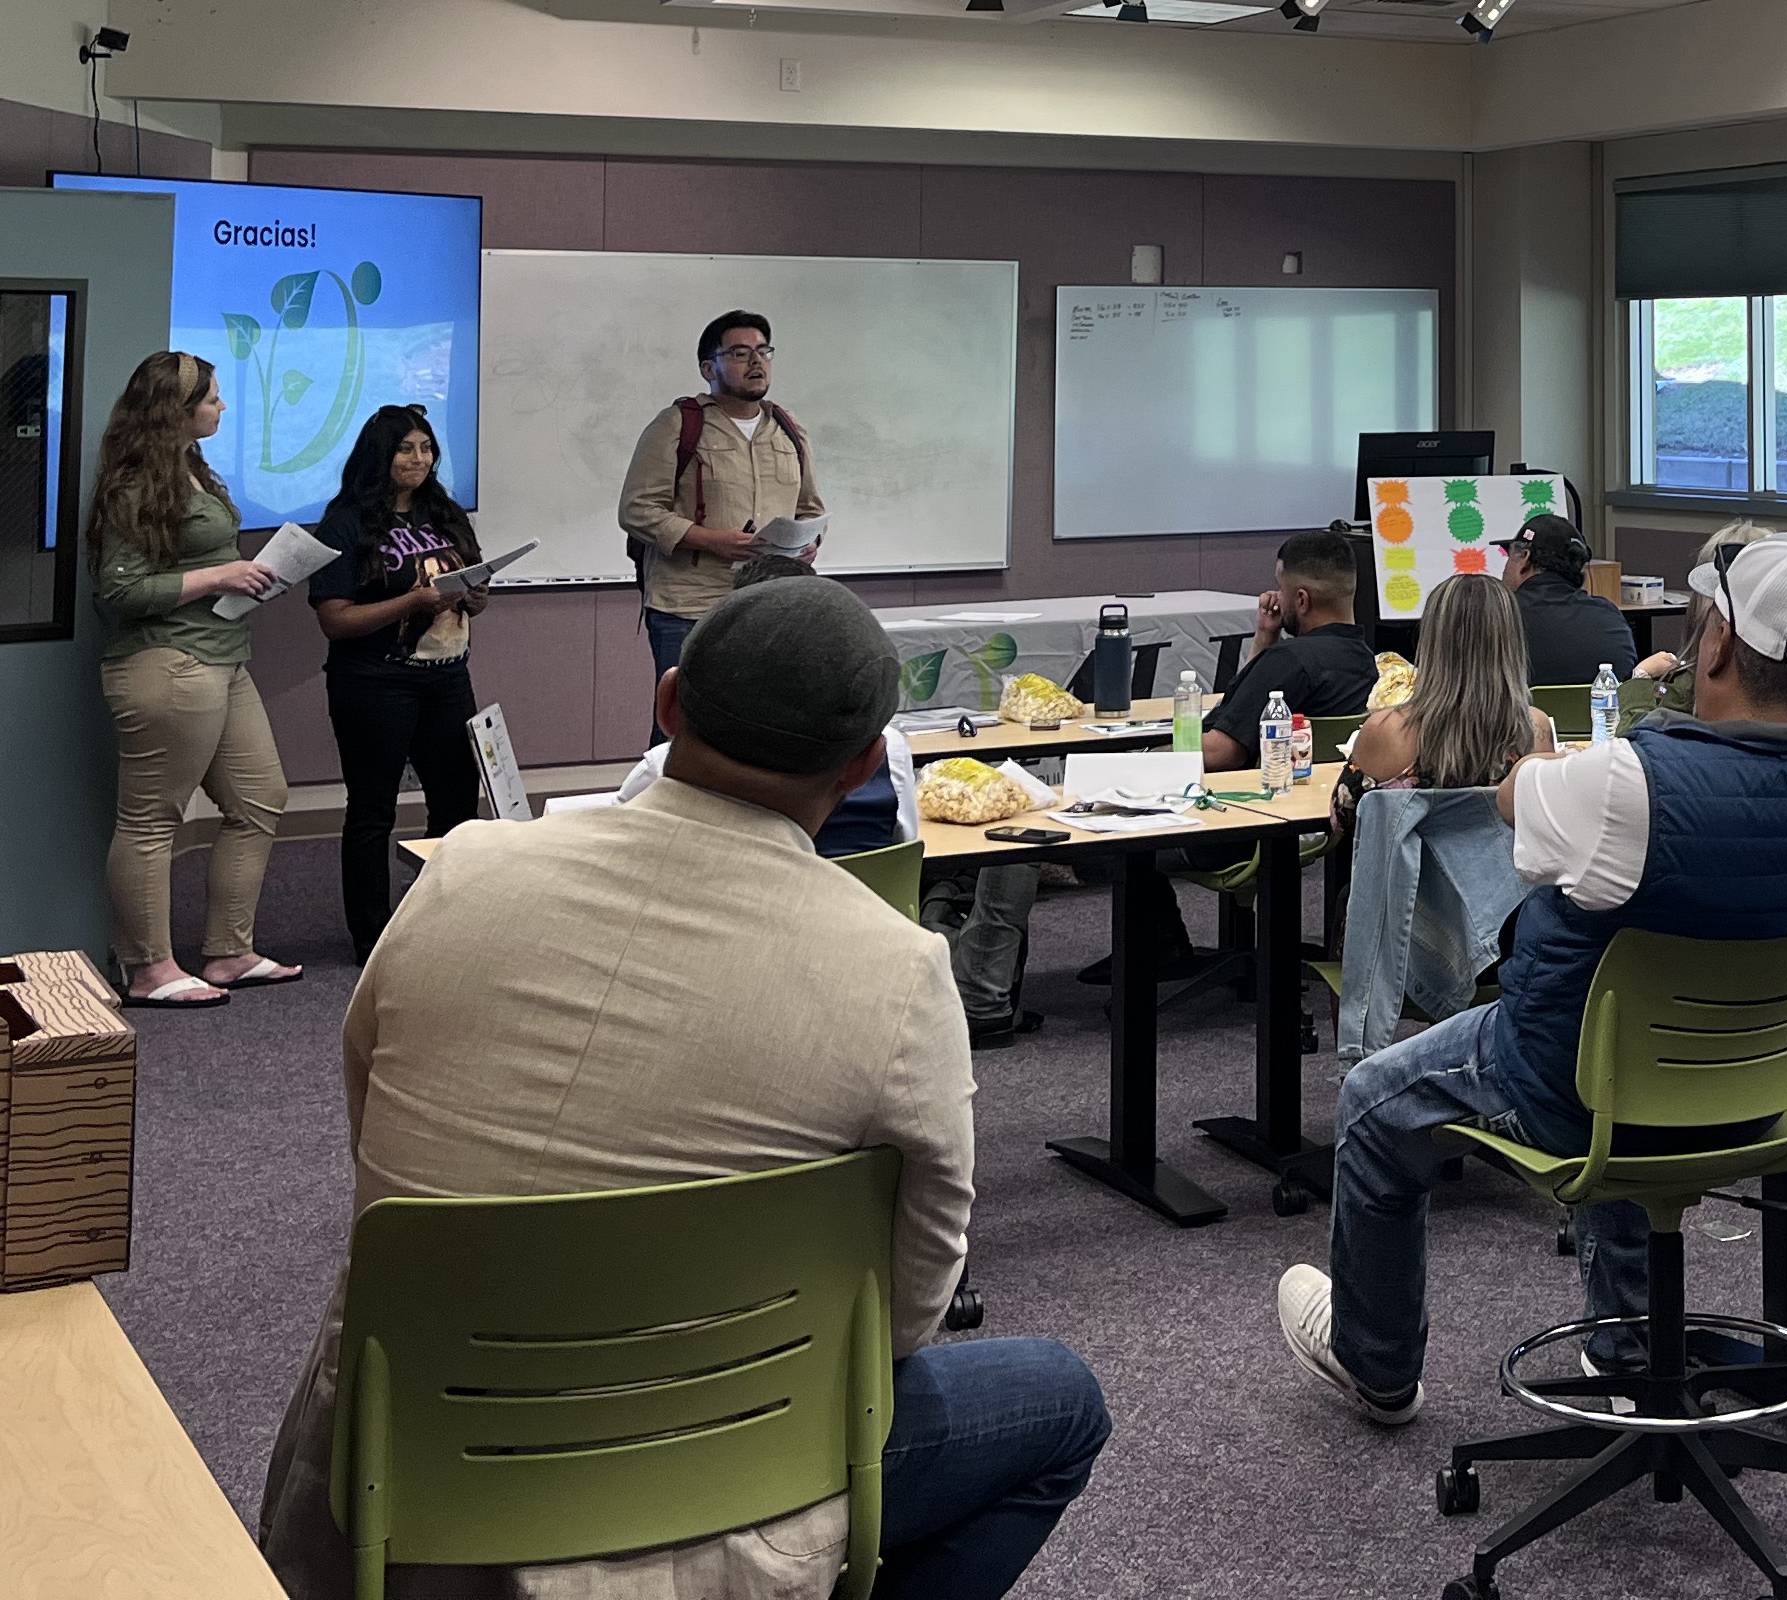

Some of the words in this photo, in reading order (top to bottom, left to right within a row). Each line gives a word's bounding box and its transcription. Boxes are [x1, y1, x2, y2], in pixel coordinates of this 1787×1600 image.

[214, 219, 316, 248] Gracias!
[1416, 439, 1441, 448] acer
[379, 523, 454, 572] SELE
